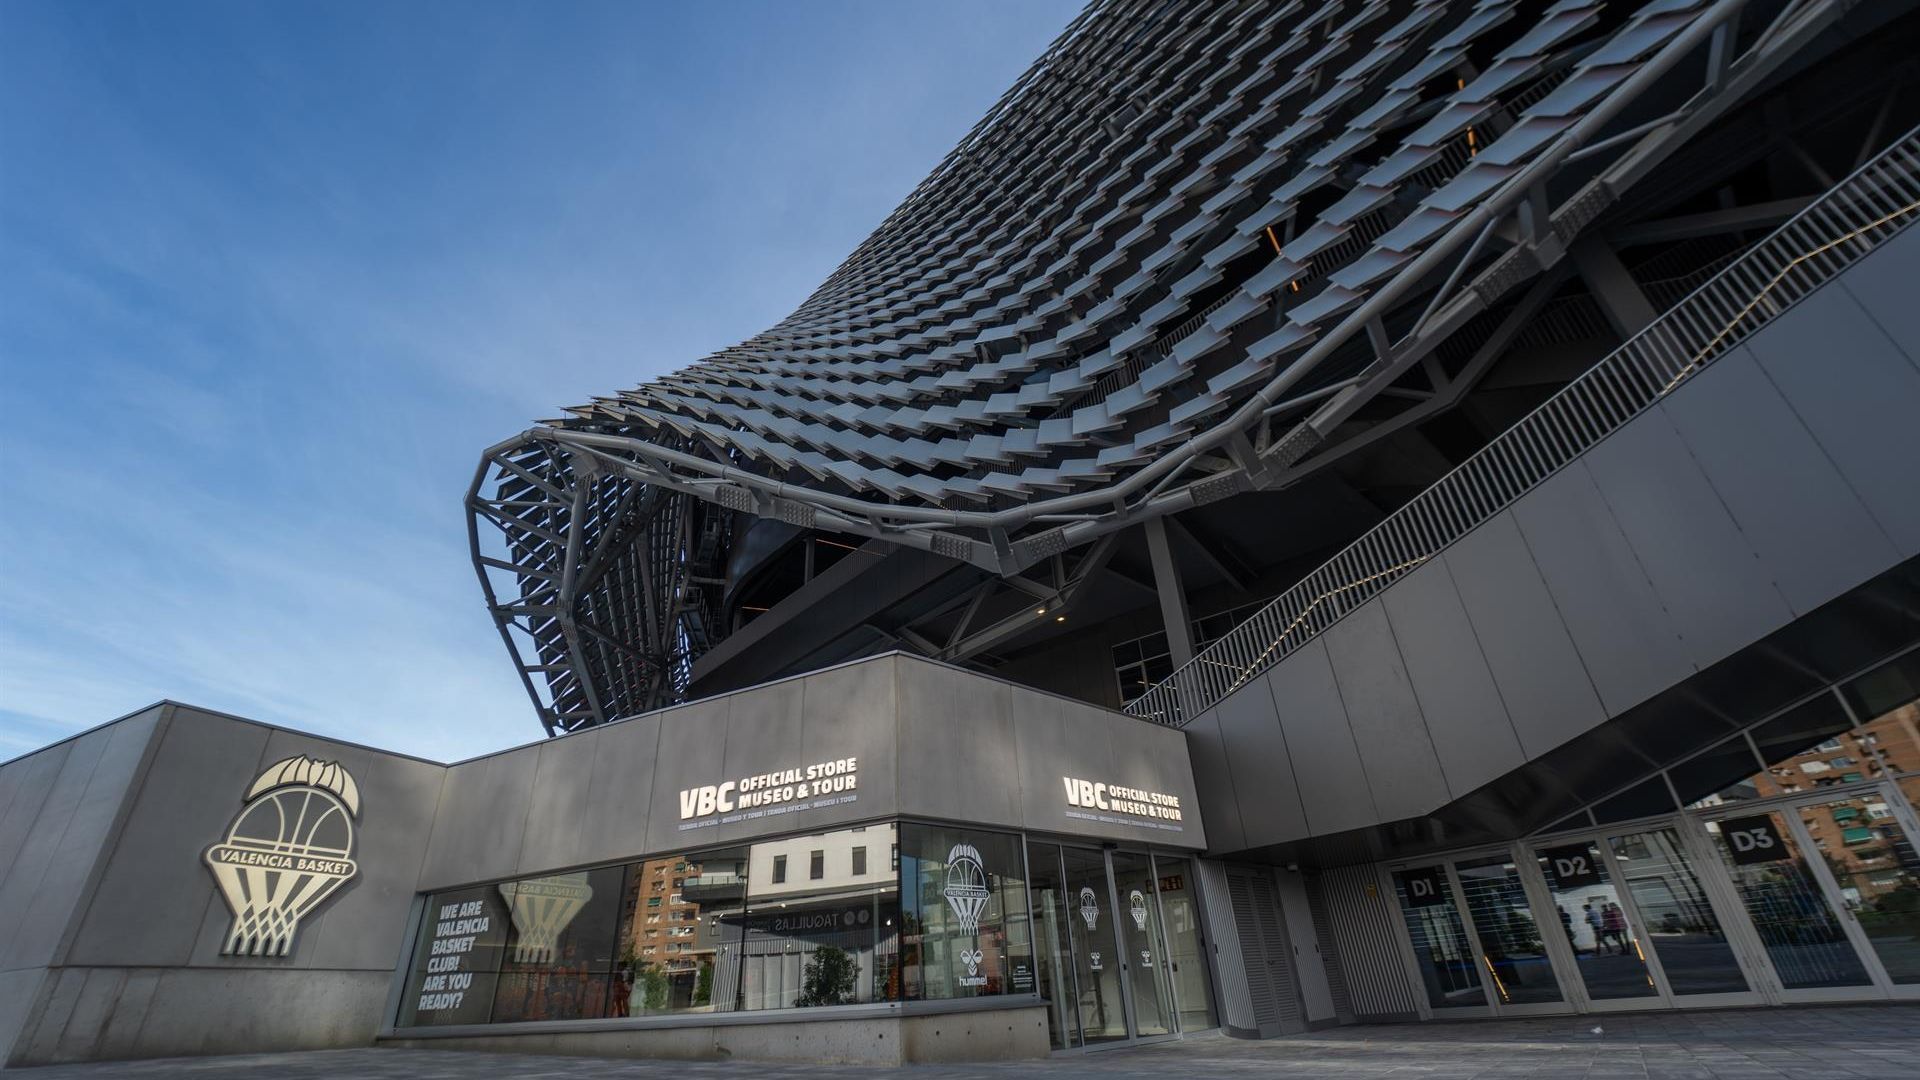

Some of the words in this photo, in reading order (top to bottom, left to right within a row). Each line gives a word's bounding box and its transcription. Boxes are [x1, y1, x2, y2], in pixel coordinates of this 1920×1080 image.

[740, 768, 803, 793] OFFICIAL
[807, 757, 857, 780] STORE
[680, 781, 735, 820] VBC
[738, 786, 793, 809] MUSEO
[797, 785, 809, 800] &
[812, 775, 857, 796] TOUR
[1064, 777, 1109, 810] VBC
[1109, 785, 1150, 803] OFFICIAL
[1151, 792, 1180, 808] STORE
[1111, 800, 1147, 817] MUSEO
[1149, 805, 1157, 817] &
[1157, 807, 1183, 821] TOUR
[1730, 828, 1774, 851] D3
[219, 849, 293, 869] VALENCIA
[297, 859, 349, 875] BASKET
[1555, 856, 1590, 877] D2
[1411, 878, 1435, 896] D1
[440, 904, 457, 920] WE
[459, 900, 483, 917] ARE
[436, 917, 489, 937] VALENCIA
[431, 936, 476, 955] BASKET
[427, 955, 460, 973] CLUB!
[422, 975, 445, 991] ARE
[448, 973, 472, 989] YOU
[959, 974, 987, 987] hummel
[418, 992, 463, 1011] READY?
